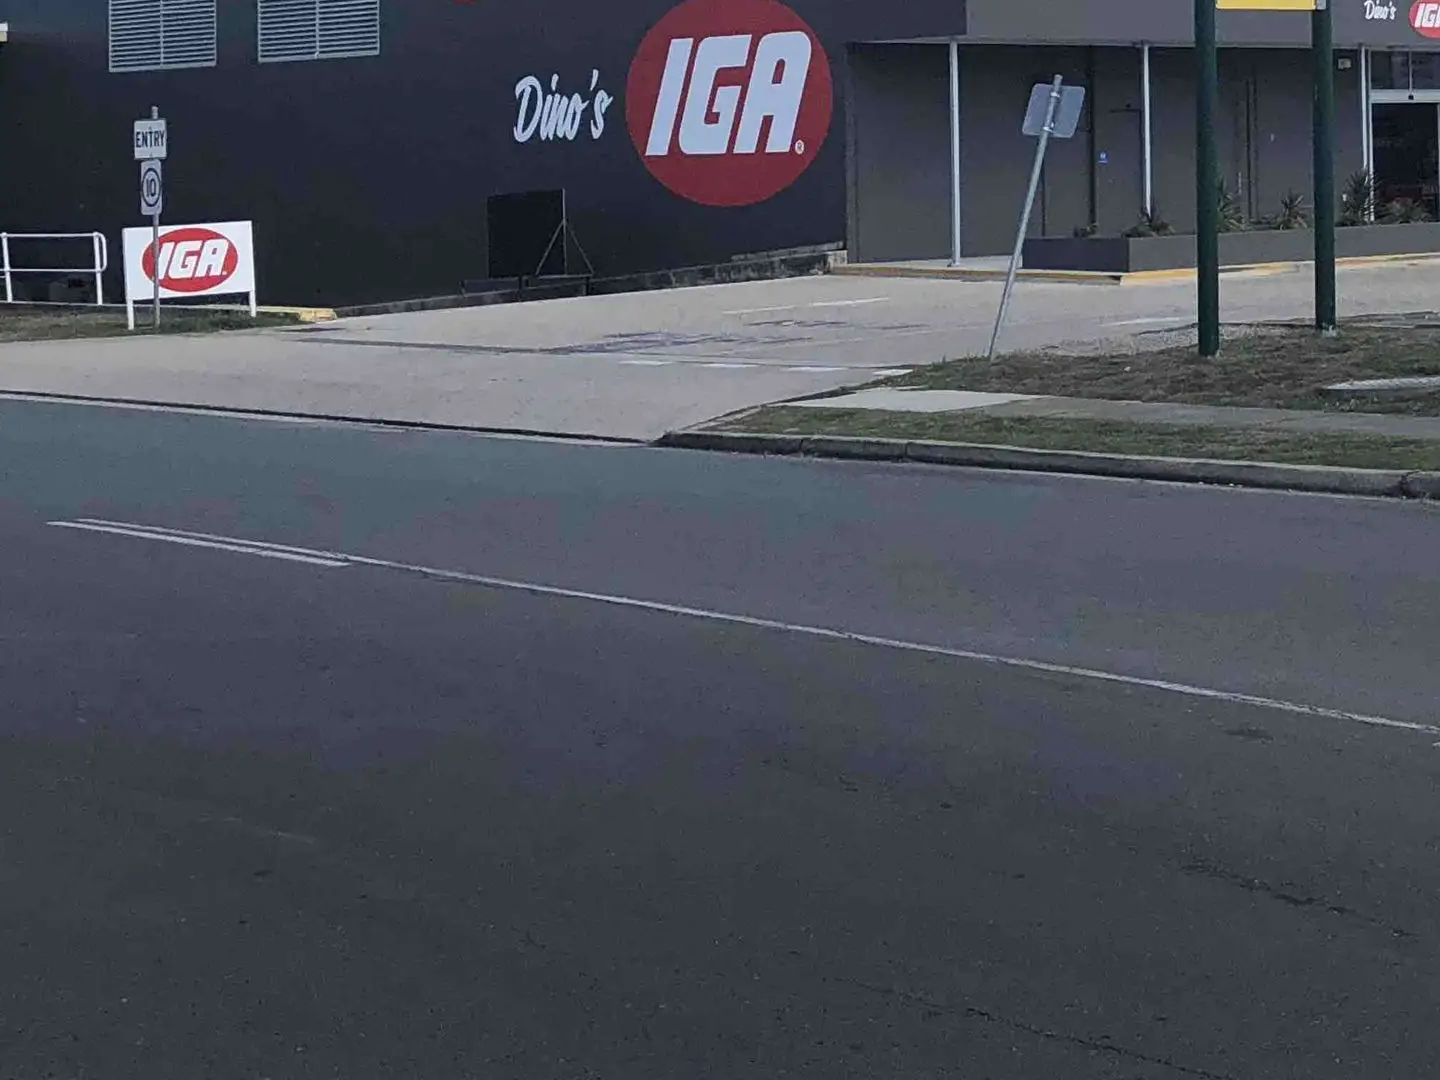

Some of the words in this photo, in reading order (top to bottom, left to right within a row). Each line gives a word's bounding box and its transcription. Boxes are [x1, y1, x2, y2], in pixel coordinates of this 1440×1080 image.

[1363, 0, 1397, 21] Dino's
[513, 69, 614, 142] Dino's
[645, 30, 813, 156] IGA
[135, 130, 165, 149] ENTRY
[145, 178, 157, 198] 10
[158, 238, 229, 280] IGA
